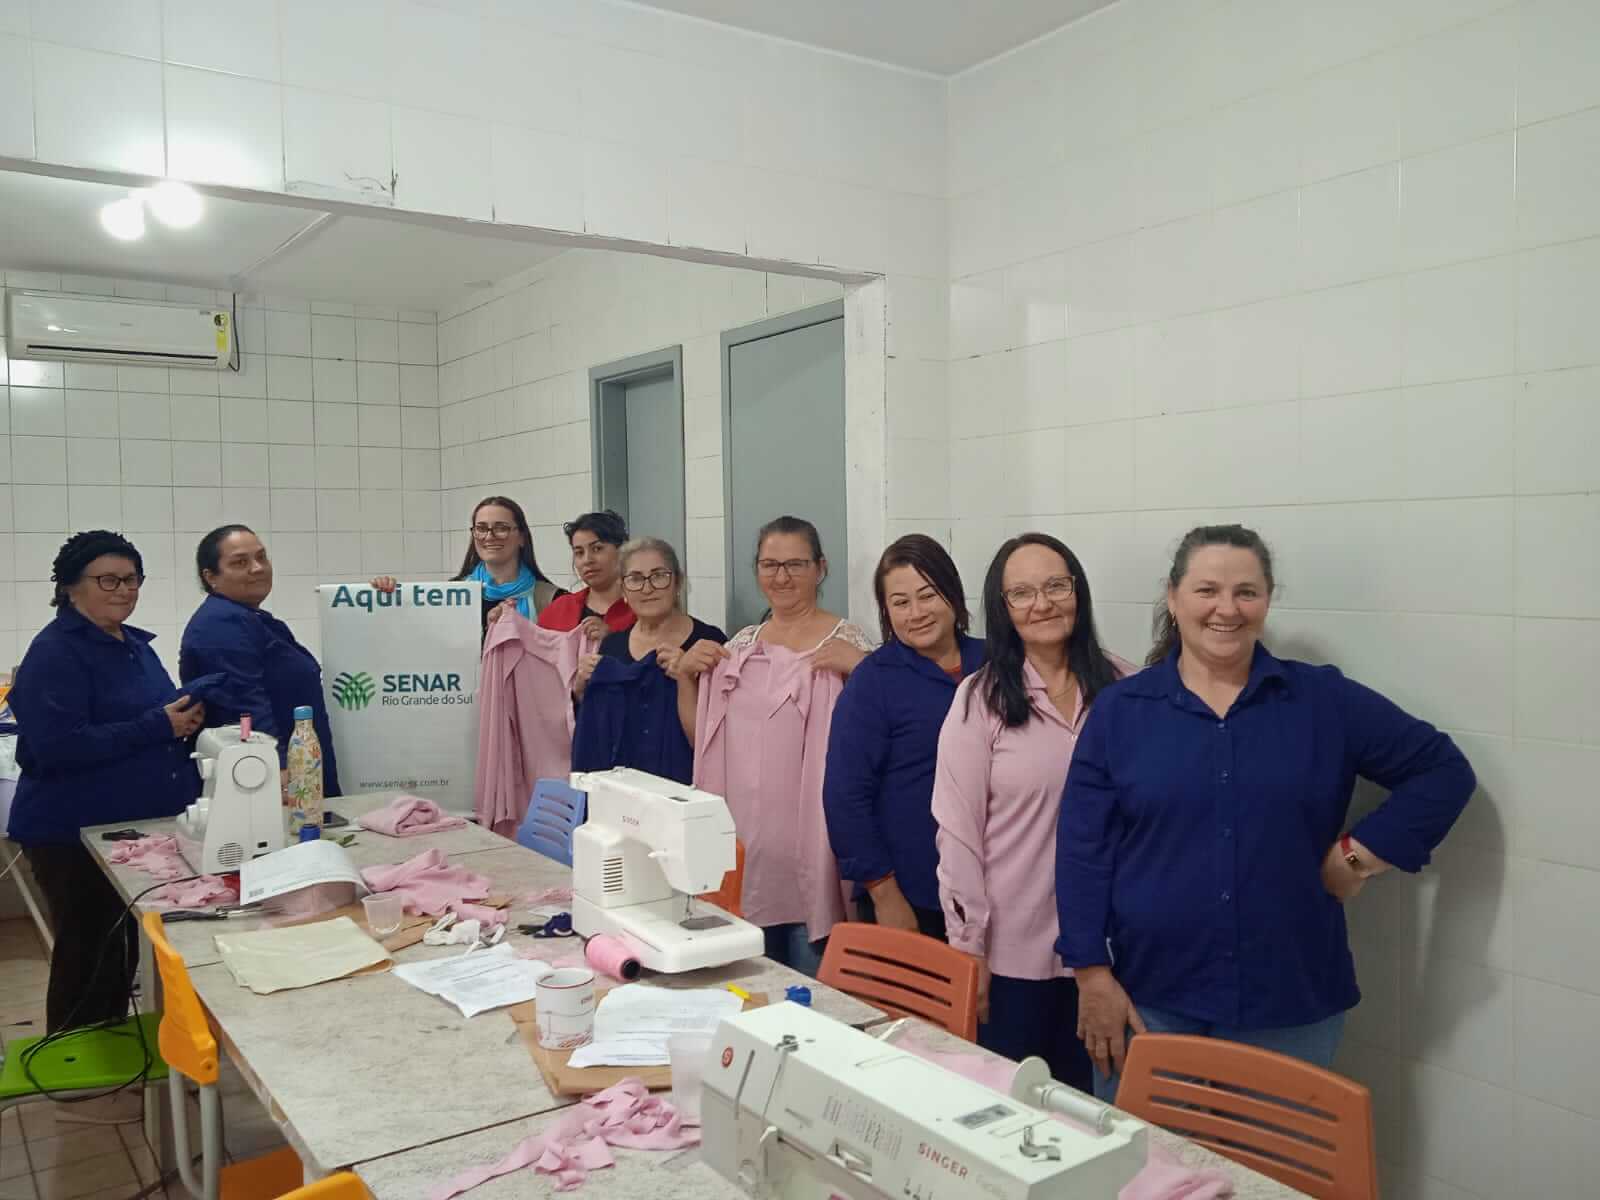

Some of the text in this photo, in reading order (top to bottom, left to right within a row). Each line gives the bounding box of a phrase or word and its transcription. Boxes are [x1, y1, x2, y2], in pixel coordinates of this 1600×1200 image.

[331, 584, 471, 612] Aqui tem
[382, 673, 461, 692] SENAR
[382, 694, 473, 706] Rio Grande do Sul
[918, 1142, 968, 1180] SINGER
